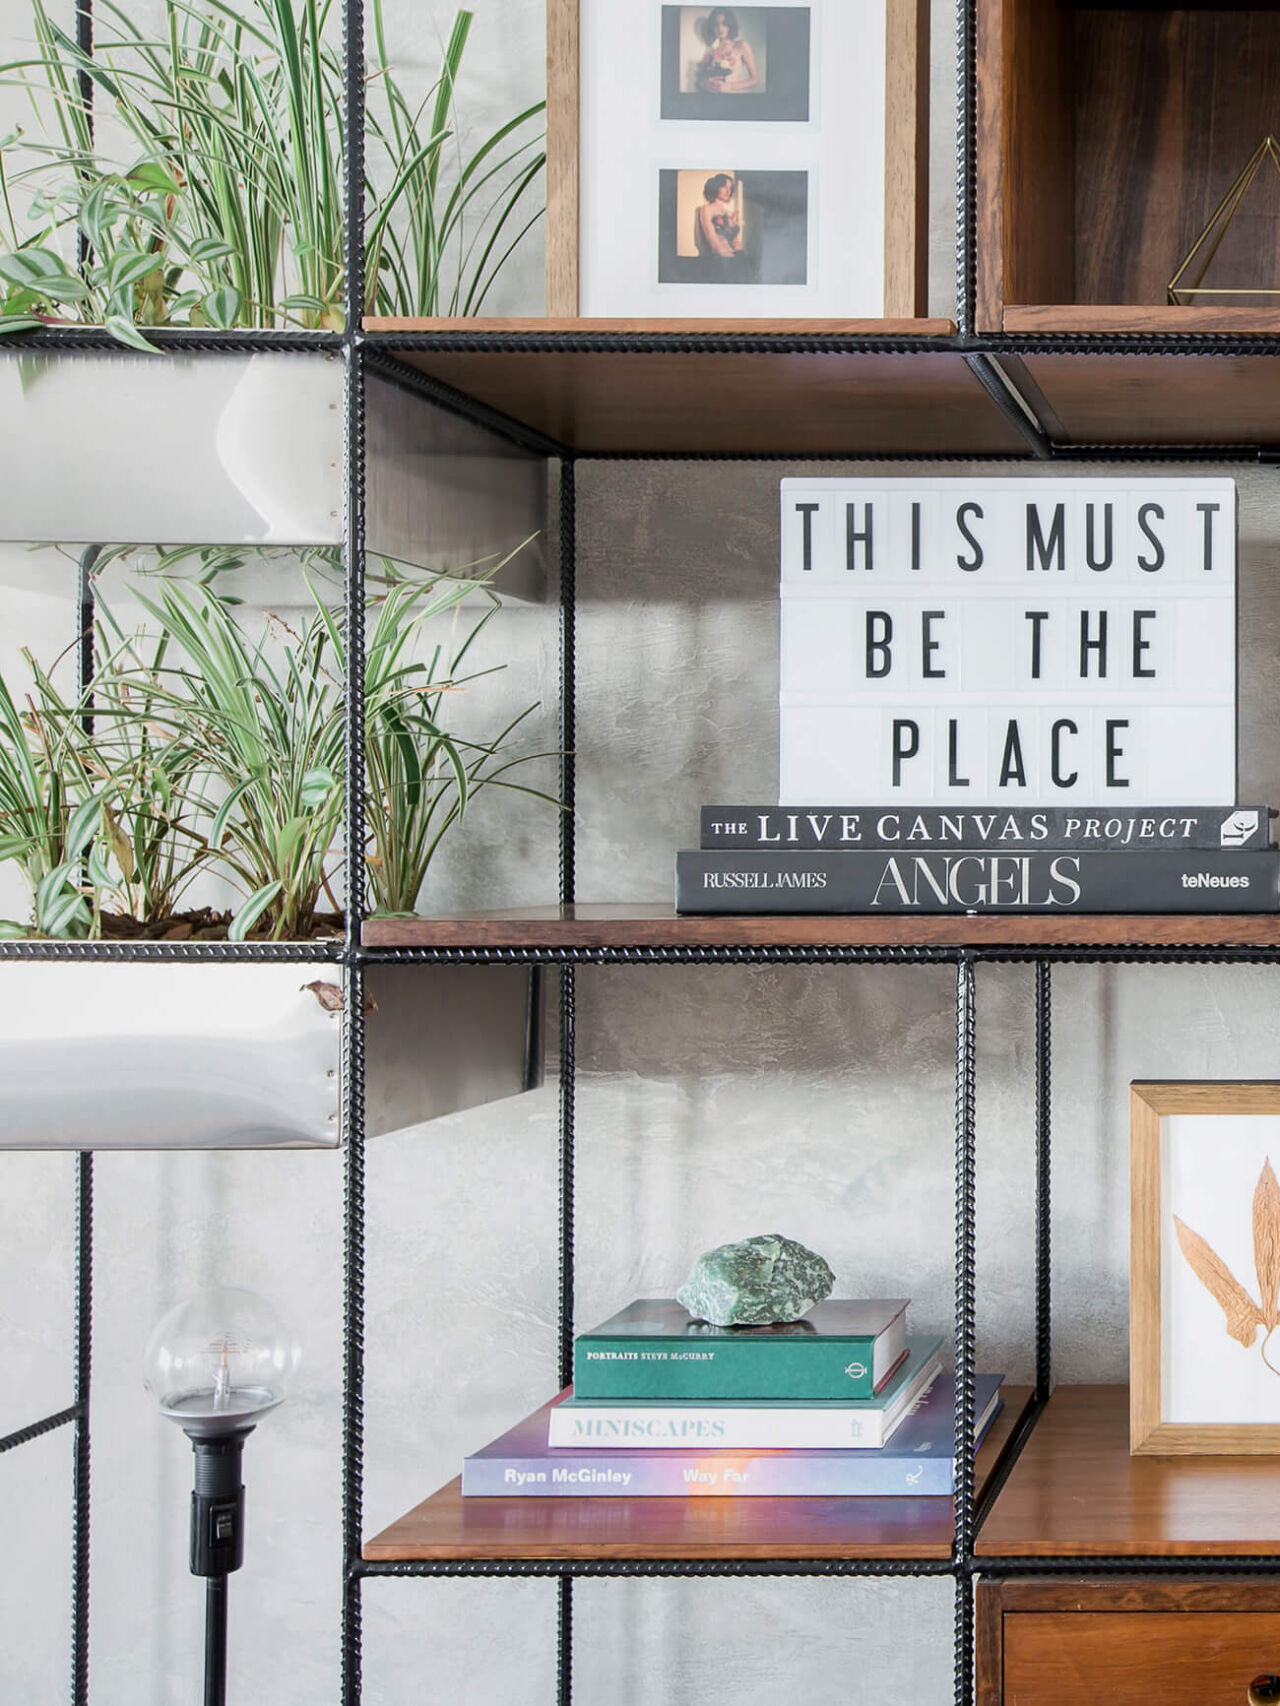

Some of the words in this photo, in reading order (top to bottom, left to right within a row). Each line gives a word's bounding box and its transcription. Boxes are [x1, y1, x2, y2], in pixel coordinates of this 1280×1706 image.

[795, 502, 984, 572] THIS
[1026, 502, 1220, 572] MUST
[865, 610, 946, 679] BE
[1025, 610, 1156, 679] THE
[892, 718, 1129, 788] PLACE
[711, 822, 748, 835] THE
[757, 814, 862, 842] LIVE
[876, 814, 1049, 842] CANVAS
[1063, 818, 1198, 845] PROJECT
[703, 872, 773, 889] RUSSELL
[774, 872, 827, 889] JAMES
[870, 856, 1081, 906] ANGELS
[1181, 872, 1250, 889] teNeues
[586, 1352, 638, 1360] PORTRAITS
[573, 1418, 725, 1437] MINISCAPES
[504, 1468, 547, 1486] Ryan
[552, 1467, 632, 1485] McGinley
[683, 1468, 718, 1485] Way
[723, 1468, 750, 1483] Far
